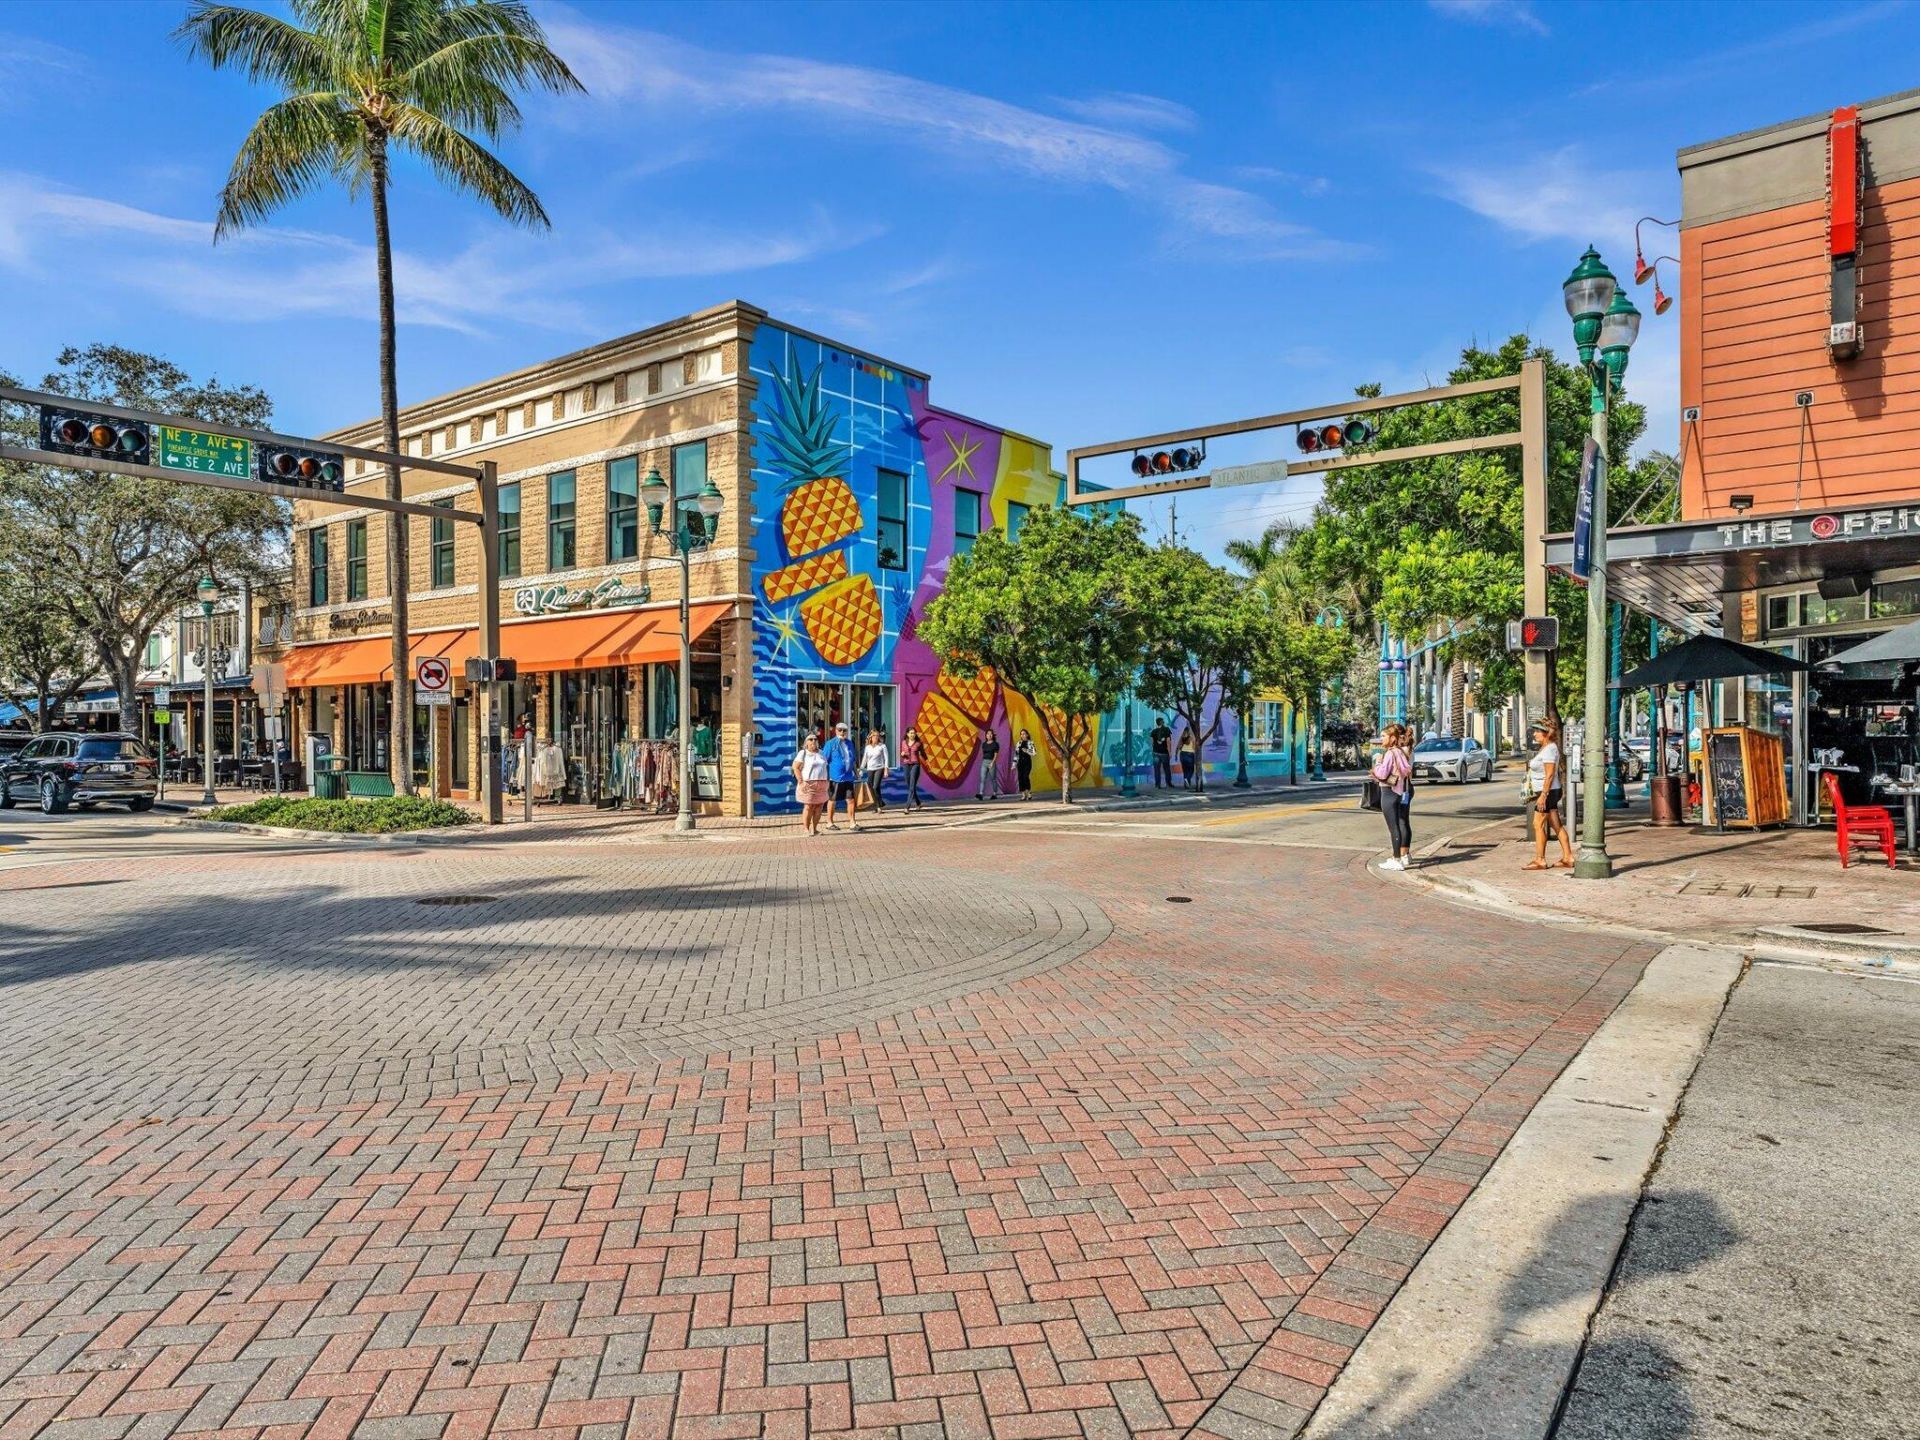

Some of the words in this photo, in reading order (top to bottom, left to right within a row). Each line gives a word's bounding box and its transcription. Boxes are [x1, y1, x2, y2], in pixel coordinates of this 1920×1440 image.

[166, 429, 181, 442] NE
[190, 432, 198, 445] 2
[207, 435, 228, 450] AVE
[185, 456, 200, 469] SE
[208, 459, 215, 471] 2
[223, 461, 244, 475] AVE
[1717, 519, 1793, 546] THE
[1810, 508, 1920, 540] OFFI
[540, 584, 593, 611] Quiet
